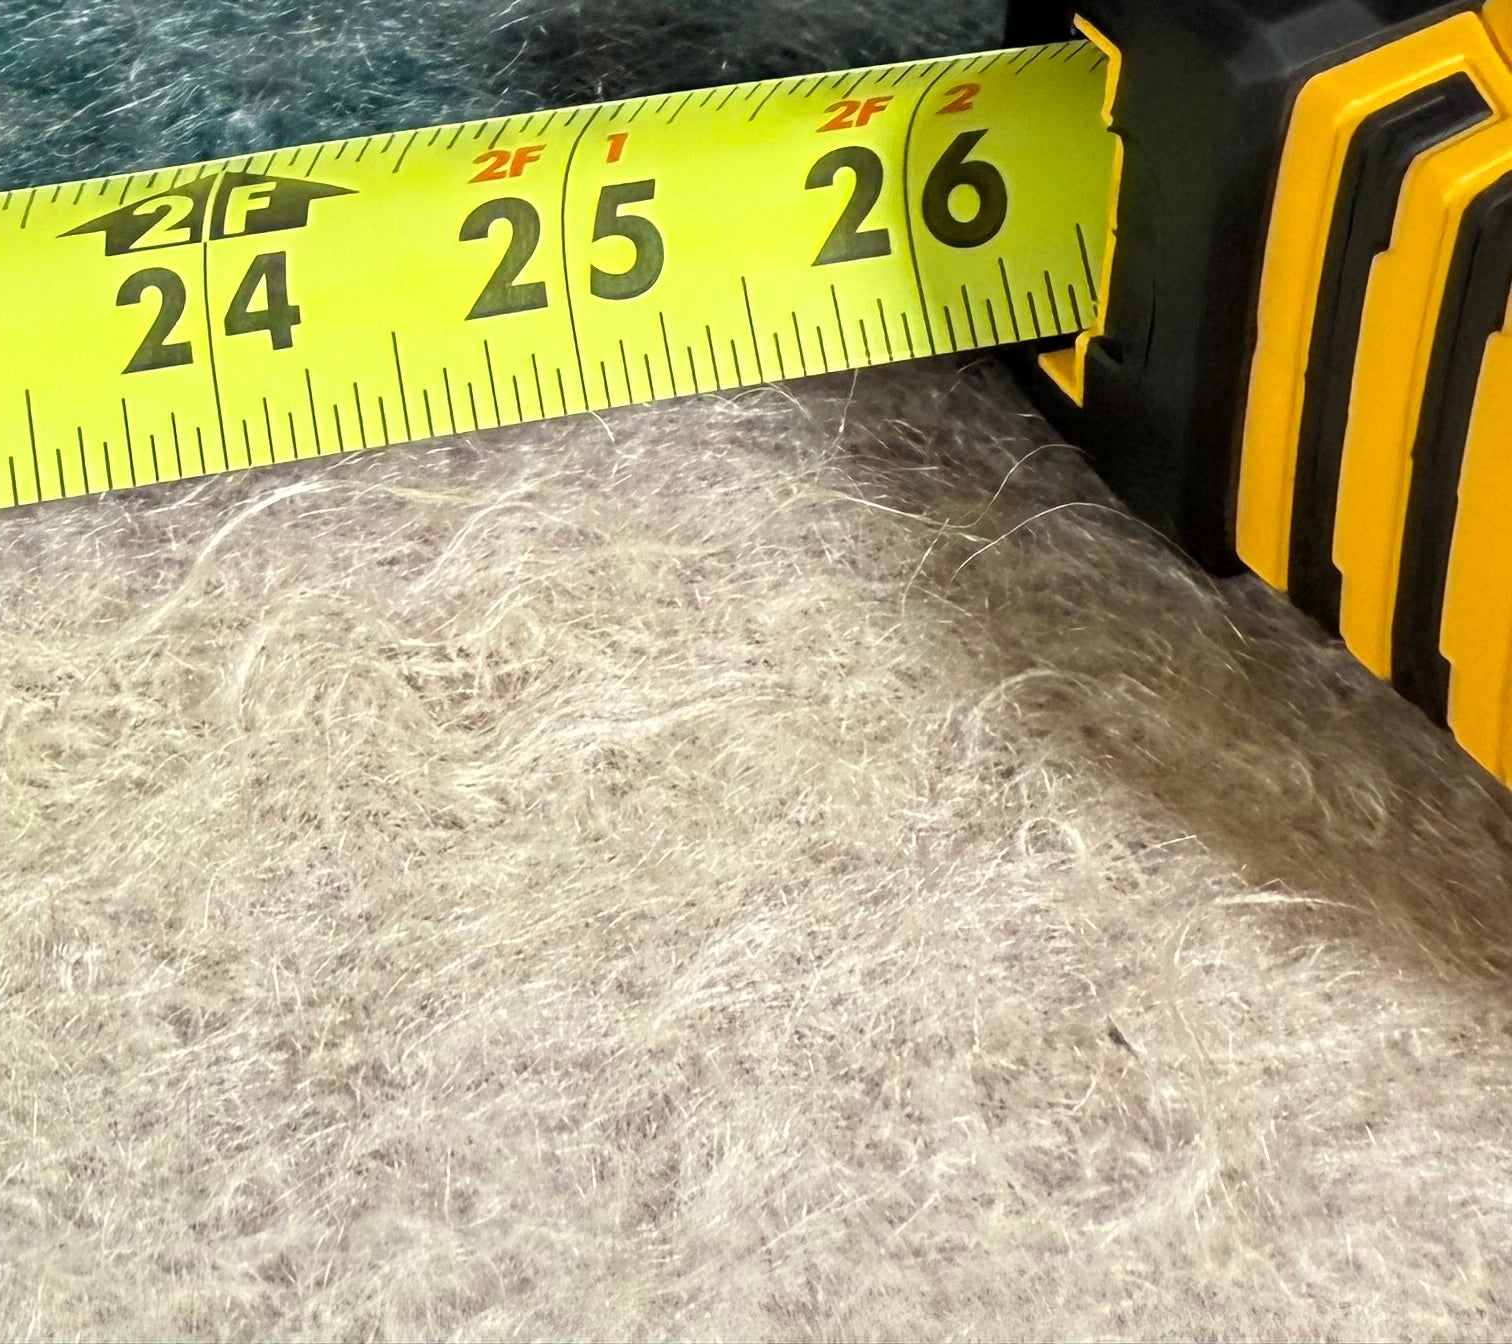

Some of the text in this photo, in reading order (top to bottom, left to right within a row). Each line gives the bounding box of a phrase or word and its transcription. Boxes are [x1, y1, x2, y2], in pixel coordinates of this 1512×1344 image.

[817, 81, 983, 133] 2F 2
[467, 132, 628, 184] 2F 1
[803, 127, 1009, 267] 26
[128, 180, 277, 250] 2F
[458, 178, 665, 322] 25
[115, 250, 302, 376] 24
